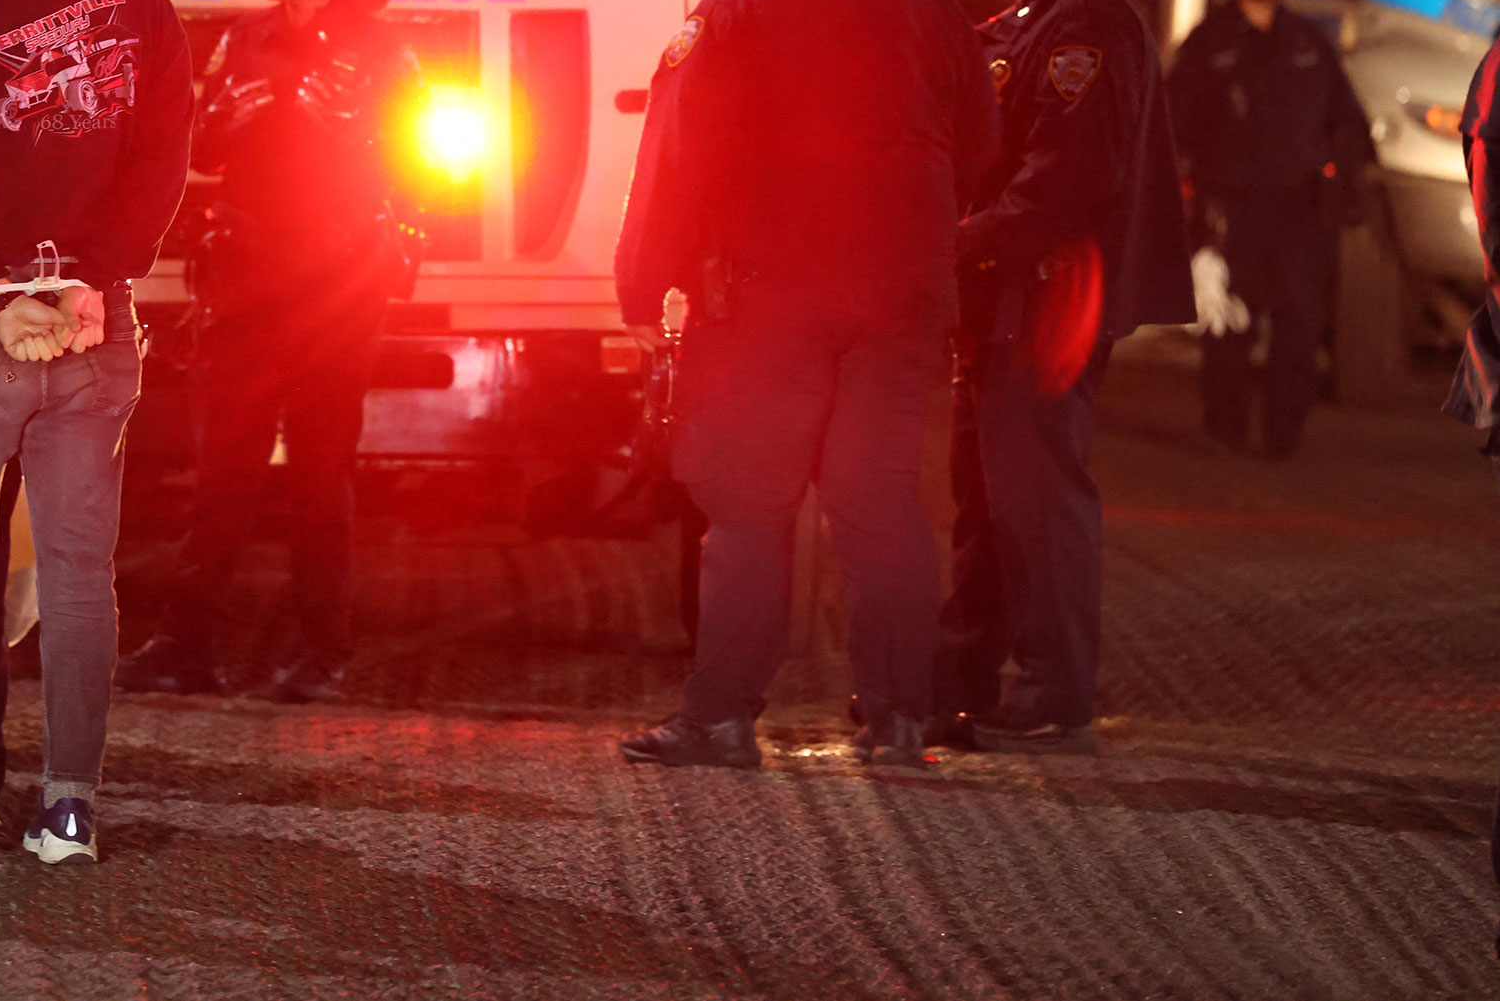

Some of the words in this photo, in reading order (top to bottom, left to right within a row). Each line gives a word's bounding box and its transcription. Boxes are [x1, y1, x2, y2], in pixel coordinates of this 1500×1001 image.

[24, 15, 90, 53] SPEEDWAY
[41, 114, 64, 130] 68
[69, 114, 117, 130] Years
